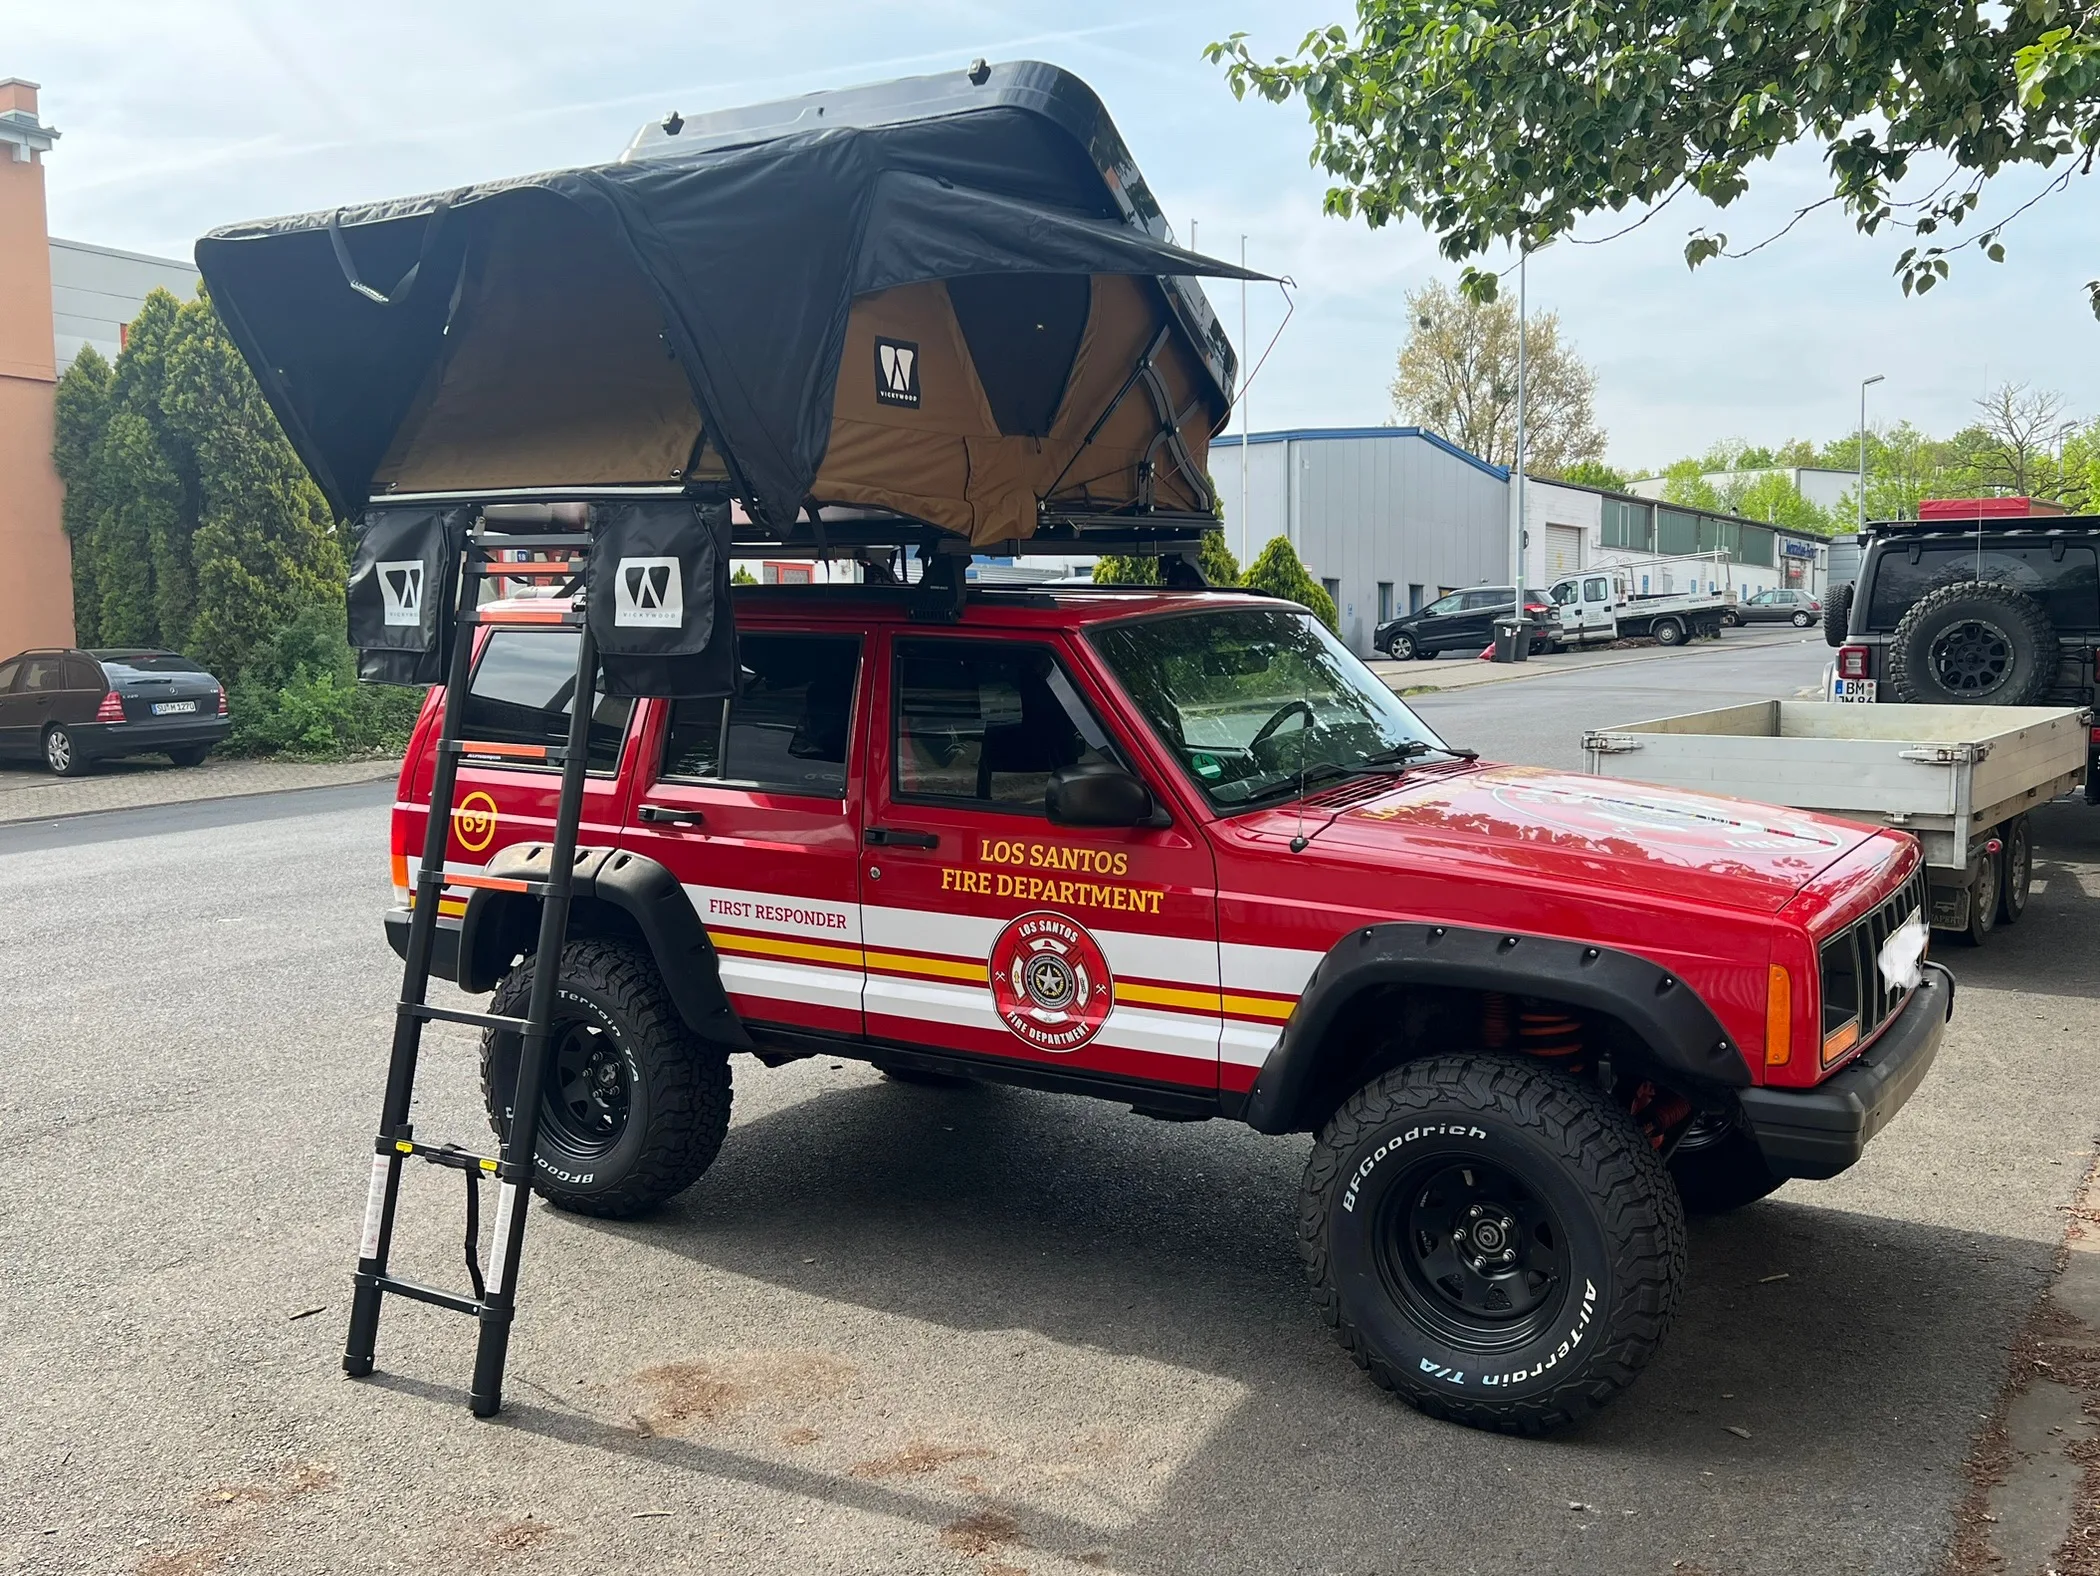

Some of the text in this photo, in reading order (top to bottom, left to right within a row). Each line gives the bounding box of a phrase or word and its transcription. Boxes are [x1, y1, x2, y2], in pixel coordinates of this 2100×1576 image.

[880, 391, 918, 402] VICKYWOOD
[517, 553, 527, 561] 18
[623, 611, 676, 619] VICKYWOOD
[1846, 682, 1865, 695] BM
[462, 810, 488, 833] 69
[980, 839, 1128, 876] LOS SANTOS
[941, 868, 1164, 914] FIRE DEPARTMENT
[709, 898, 847, 929] FIRST RESPONDER
[1018, 920, 1079, 943] LOS SANTOS
[557, 989, 621, 1038] Terrain
[1006, 1010, 1090, 1045] FIRE DEPARTMENT
[1342, 1122, 1488, 1213] BFGoodrich
[1419, 1278, 1598, 1388] All-Terrain T/A
